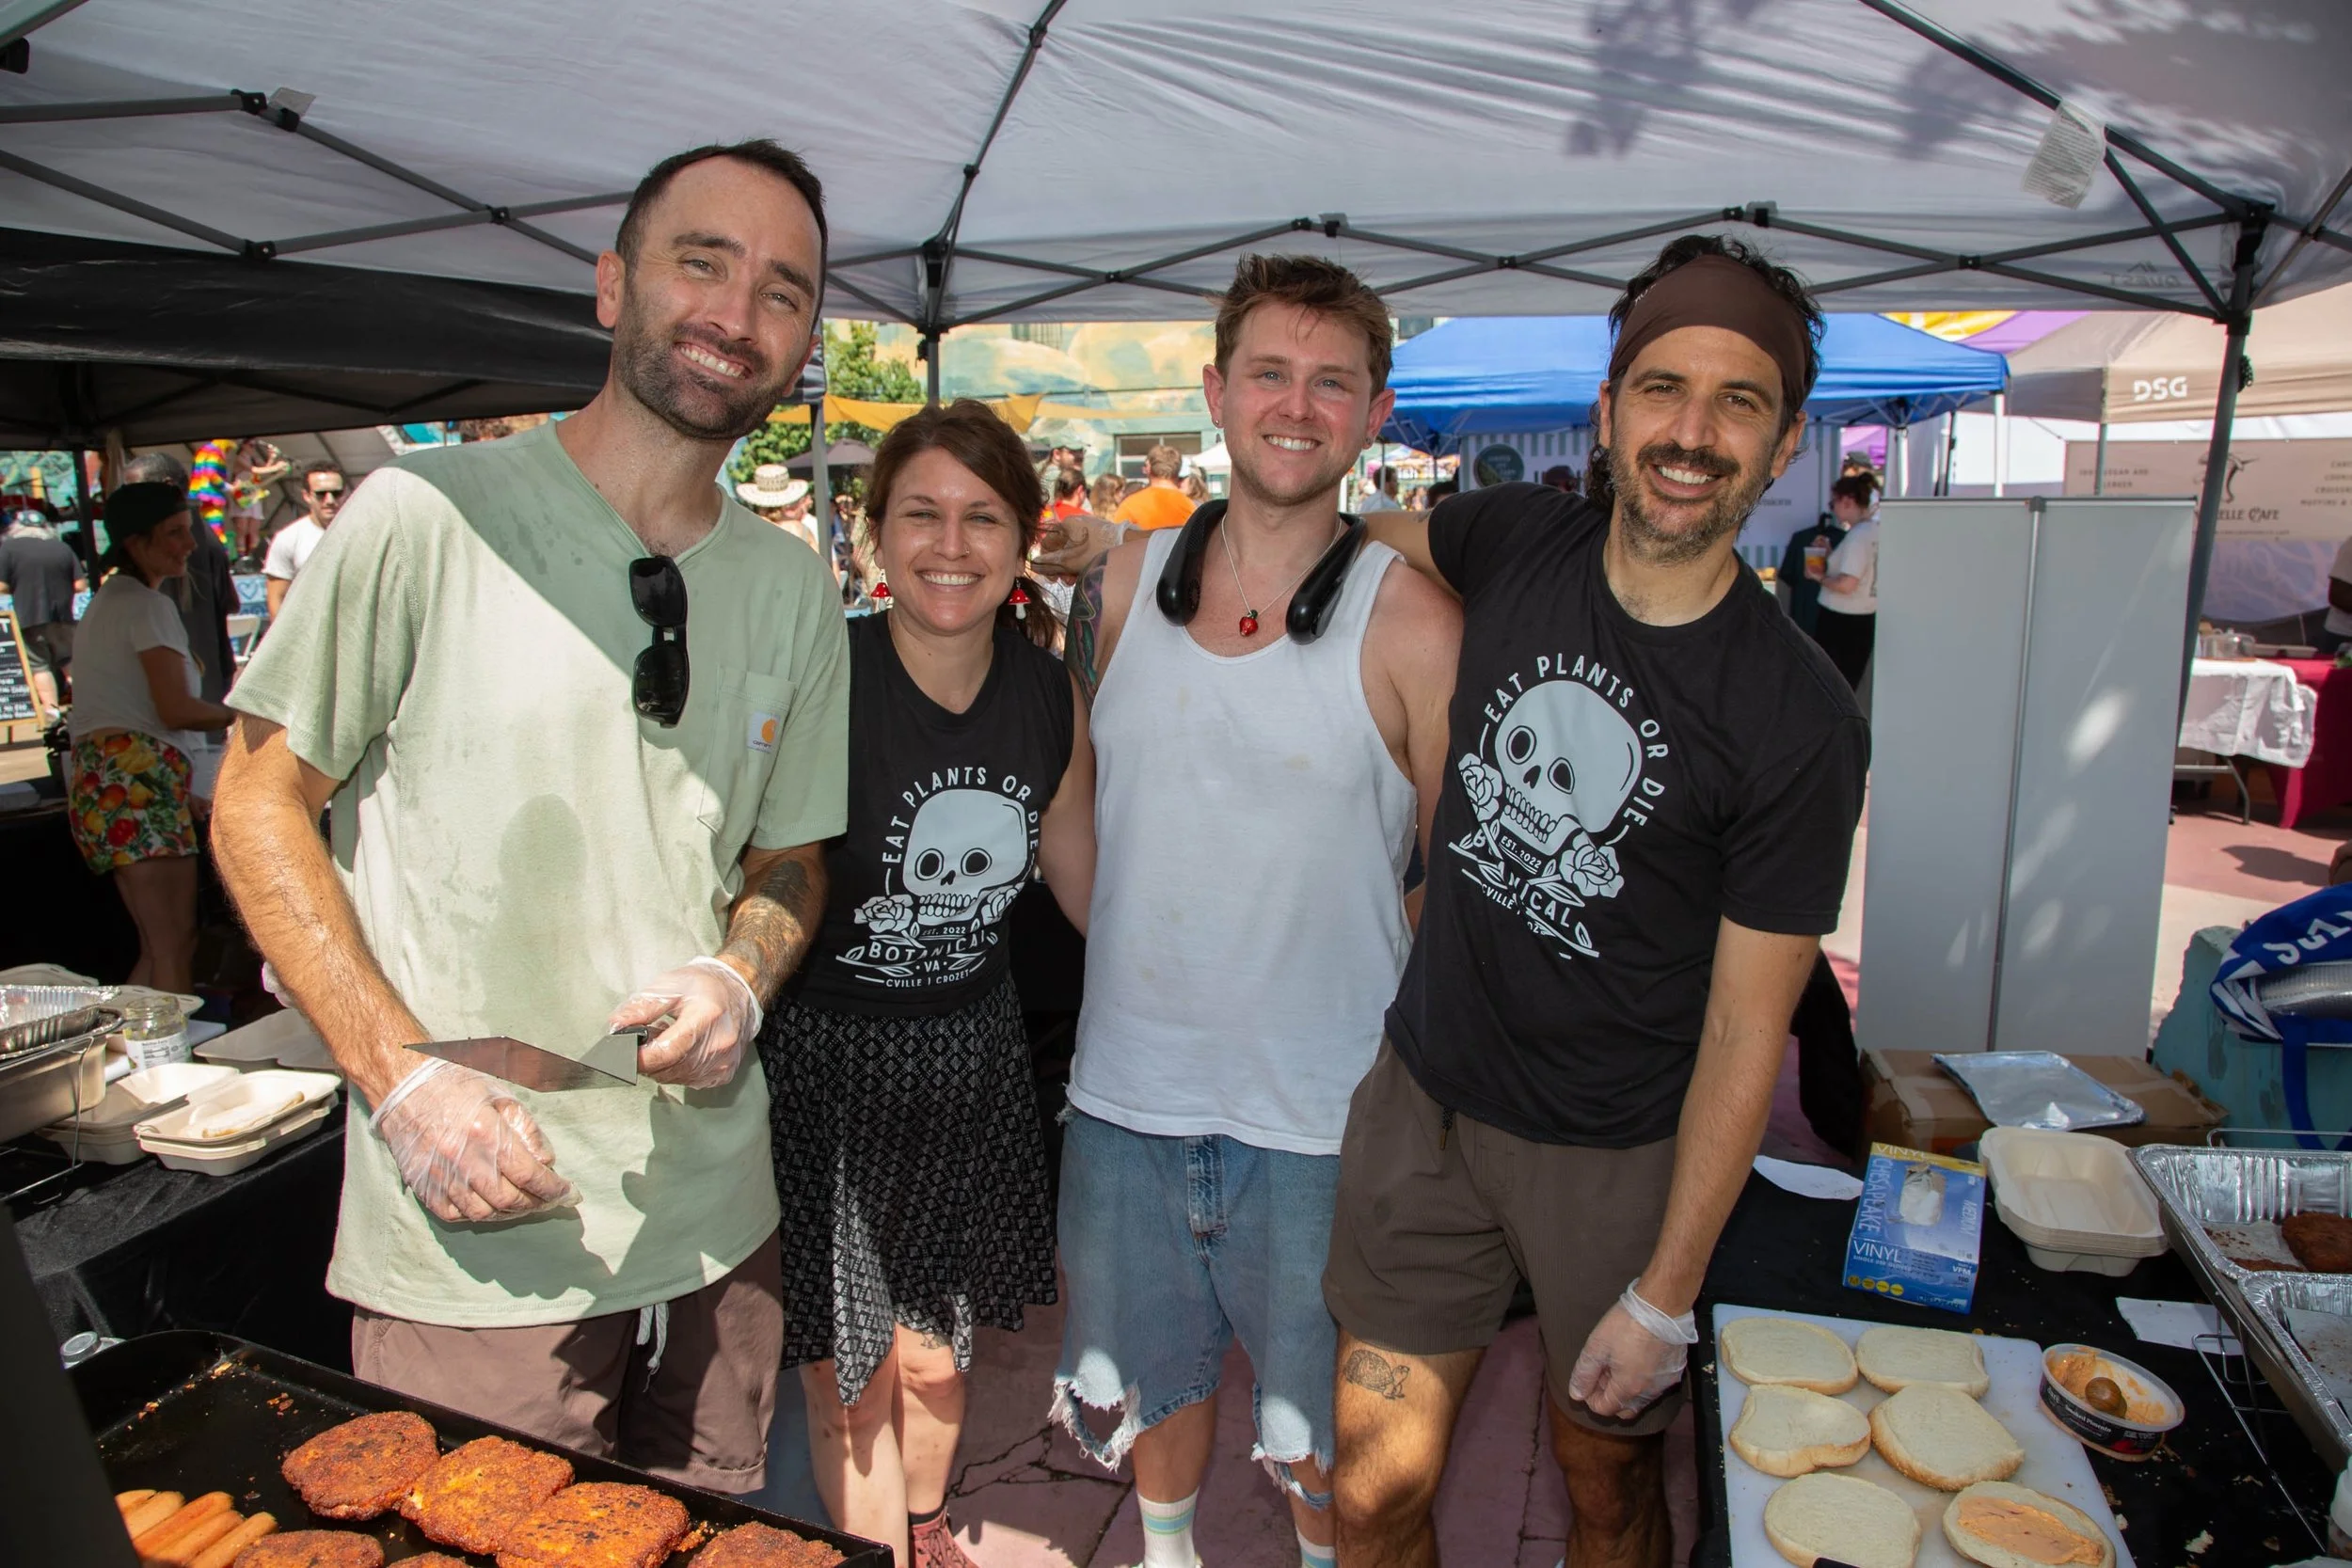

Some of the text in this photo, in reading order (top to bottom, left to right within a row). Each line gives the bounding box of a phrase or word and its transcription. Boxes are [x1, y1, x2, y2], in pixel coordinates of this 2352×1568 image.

[2134, 376, 2187, 402] DSG
[1484, 653, 1669, 827] EAT PLANTS OR DIE
[882, 767, 1039, 863] EAT PLANTS OR DIE
[1519, 851, 1543, 869] 2022
[1481, 883, 1516, 910] CVILLE
[943, 926, 966, 935] 2022
[924, 960, 941, 973] VA
[885, 969, 970, 988] CVILLE CROZET
[1858, 1158, 1894, 1232] CHESAPEAKE
[1853, 1240, 1902, 1263] VINYL
[2086, 1418, 2112, 1433] Pimento
